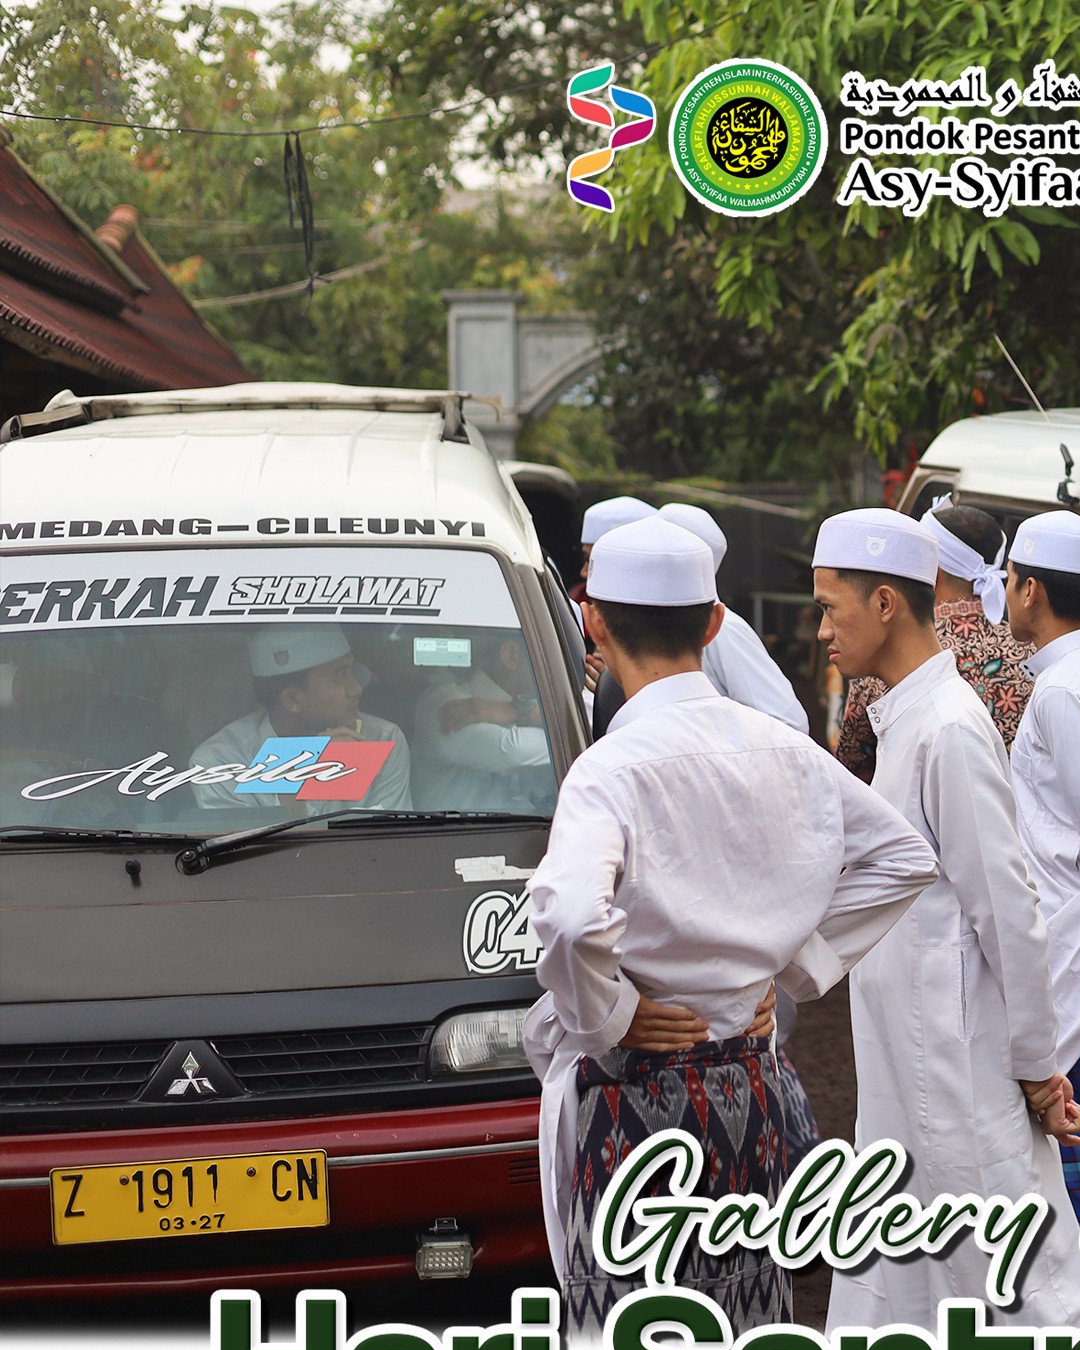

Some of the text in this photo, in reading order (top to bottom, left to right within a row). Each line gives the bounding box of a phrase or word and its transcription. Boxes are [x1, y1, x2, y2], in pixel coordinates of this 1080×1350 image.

[0, 575, 446, 625] ERKAH SHOLAWAT
[20, 750, 359, 802] Aysila
[60, 1157, 320, 1218] Z 1911 CN
